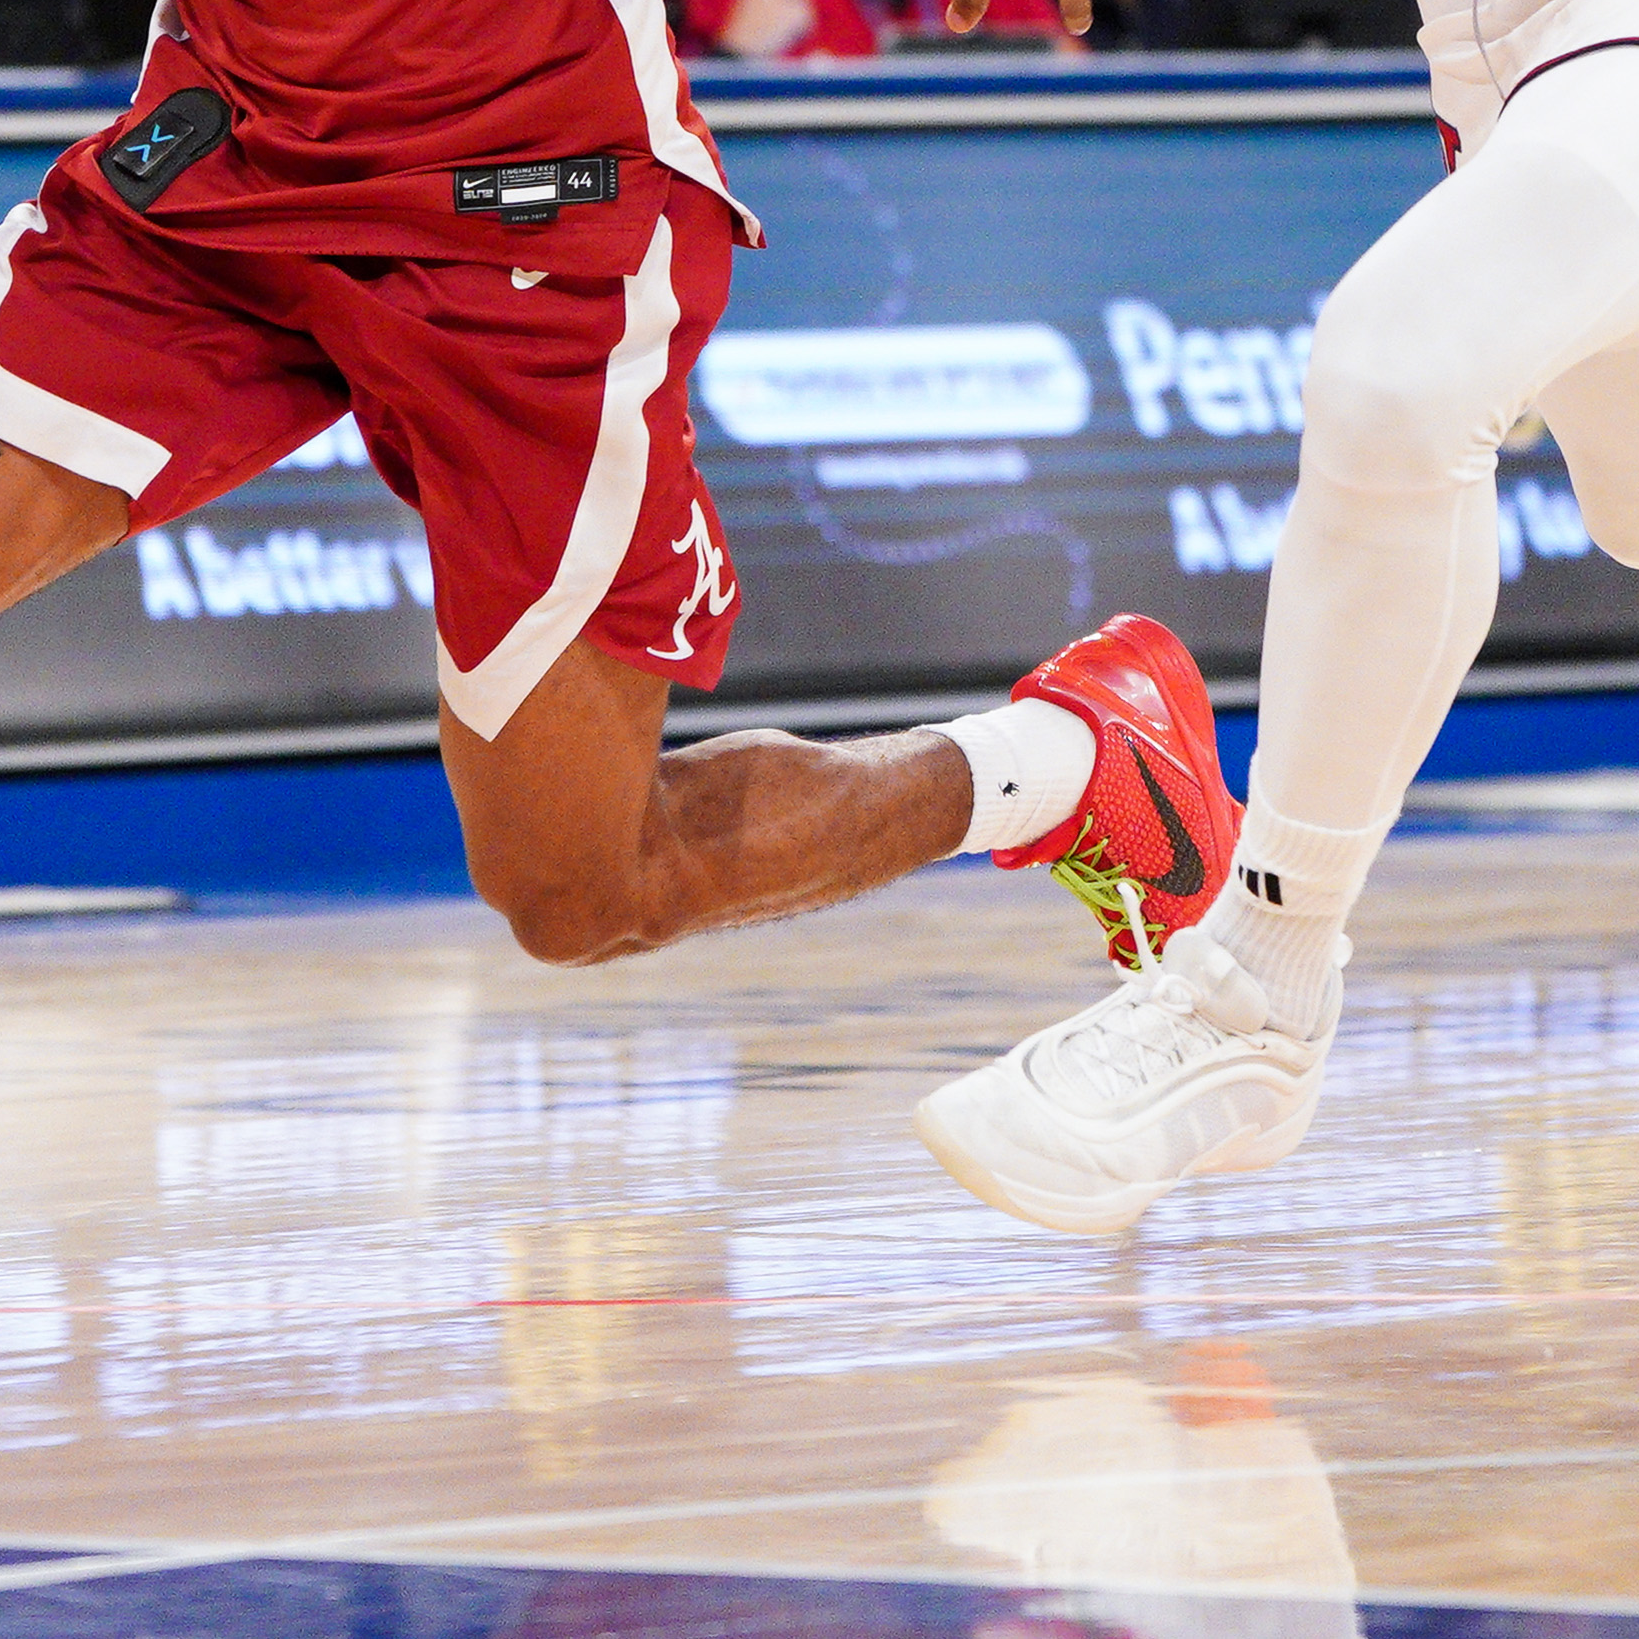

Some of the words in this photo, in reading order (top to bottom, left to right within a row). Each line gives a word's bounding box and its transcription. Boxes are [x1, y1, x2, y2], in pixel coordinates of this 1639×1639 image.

[566, 170, 593, 190] 44
[136, 529, 203, 621] A
[184, 525, 400, 618] better
[1168, 484, 1228, 575] A
